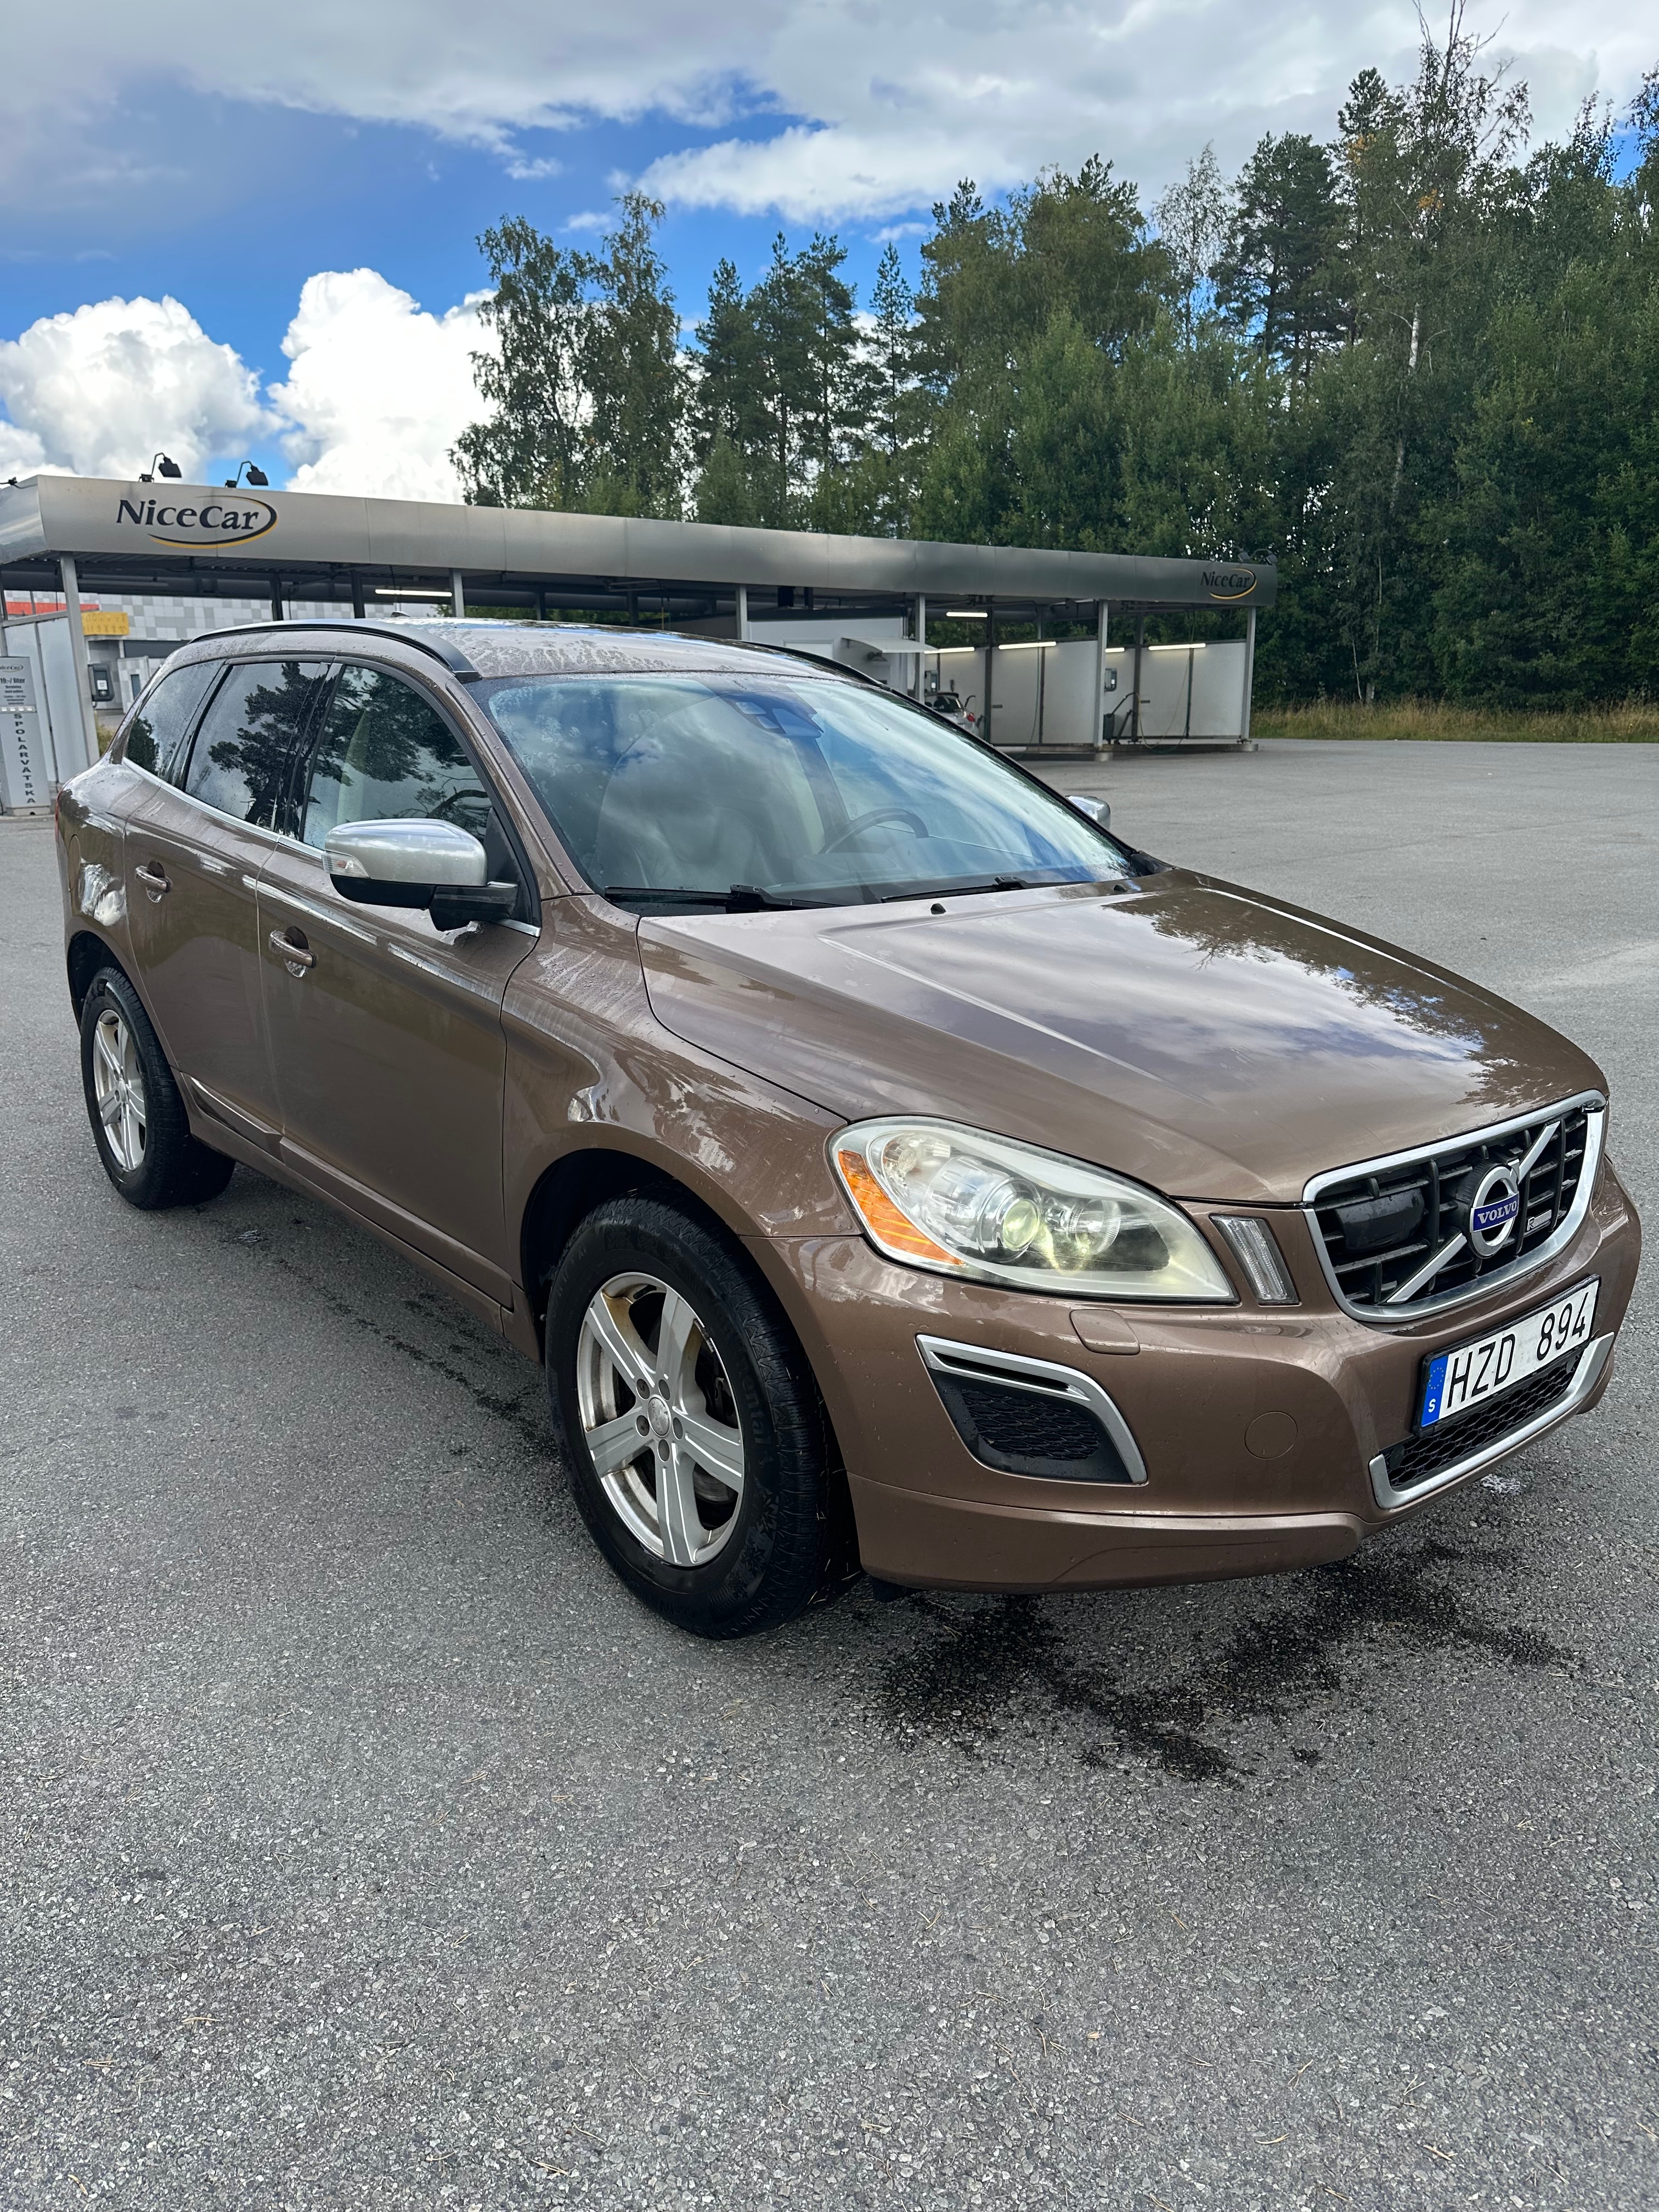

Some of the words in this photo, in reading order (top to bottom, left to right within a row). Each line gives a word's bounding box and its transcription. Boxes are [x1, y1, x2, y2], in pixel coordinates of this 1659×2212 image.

[116, 499, 259, 530] NiceCar
[1200, 571, 1250, 589] NiceCar
[1477, 1200, 1517, 1224] VOLVO
[1447, 1333, 1516, 1409] HZD
[1536, 1291, 1589, 1361] 894
[1427, 1398, 1436, 1413] S
